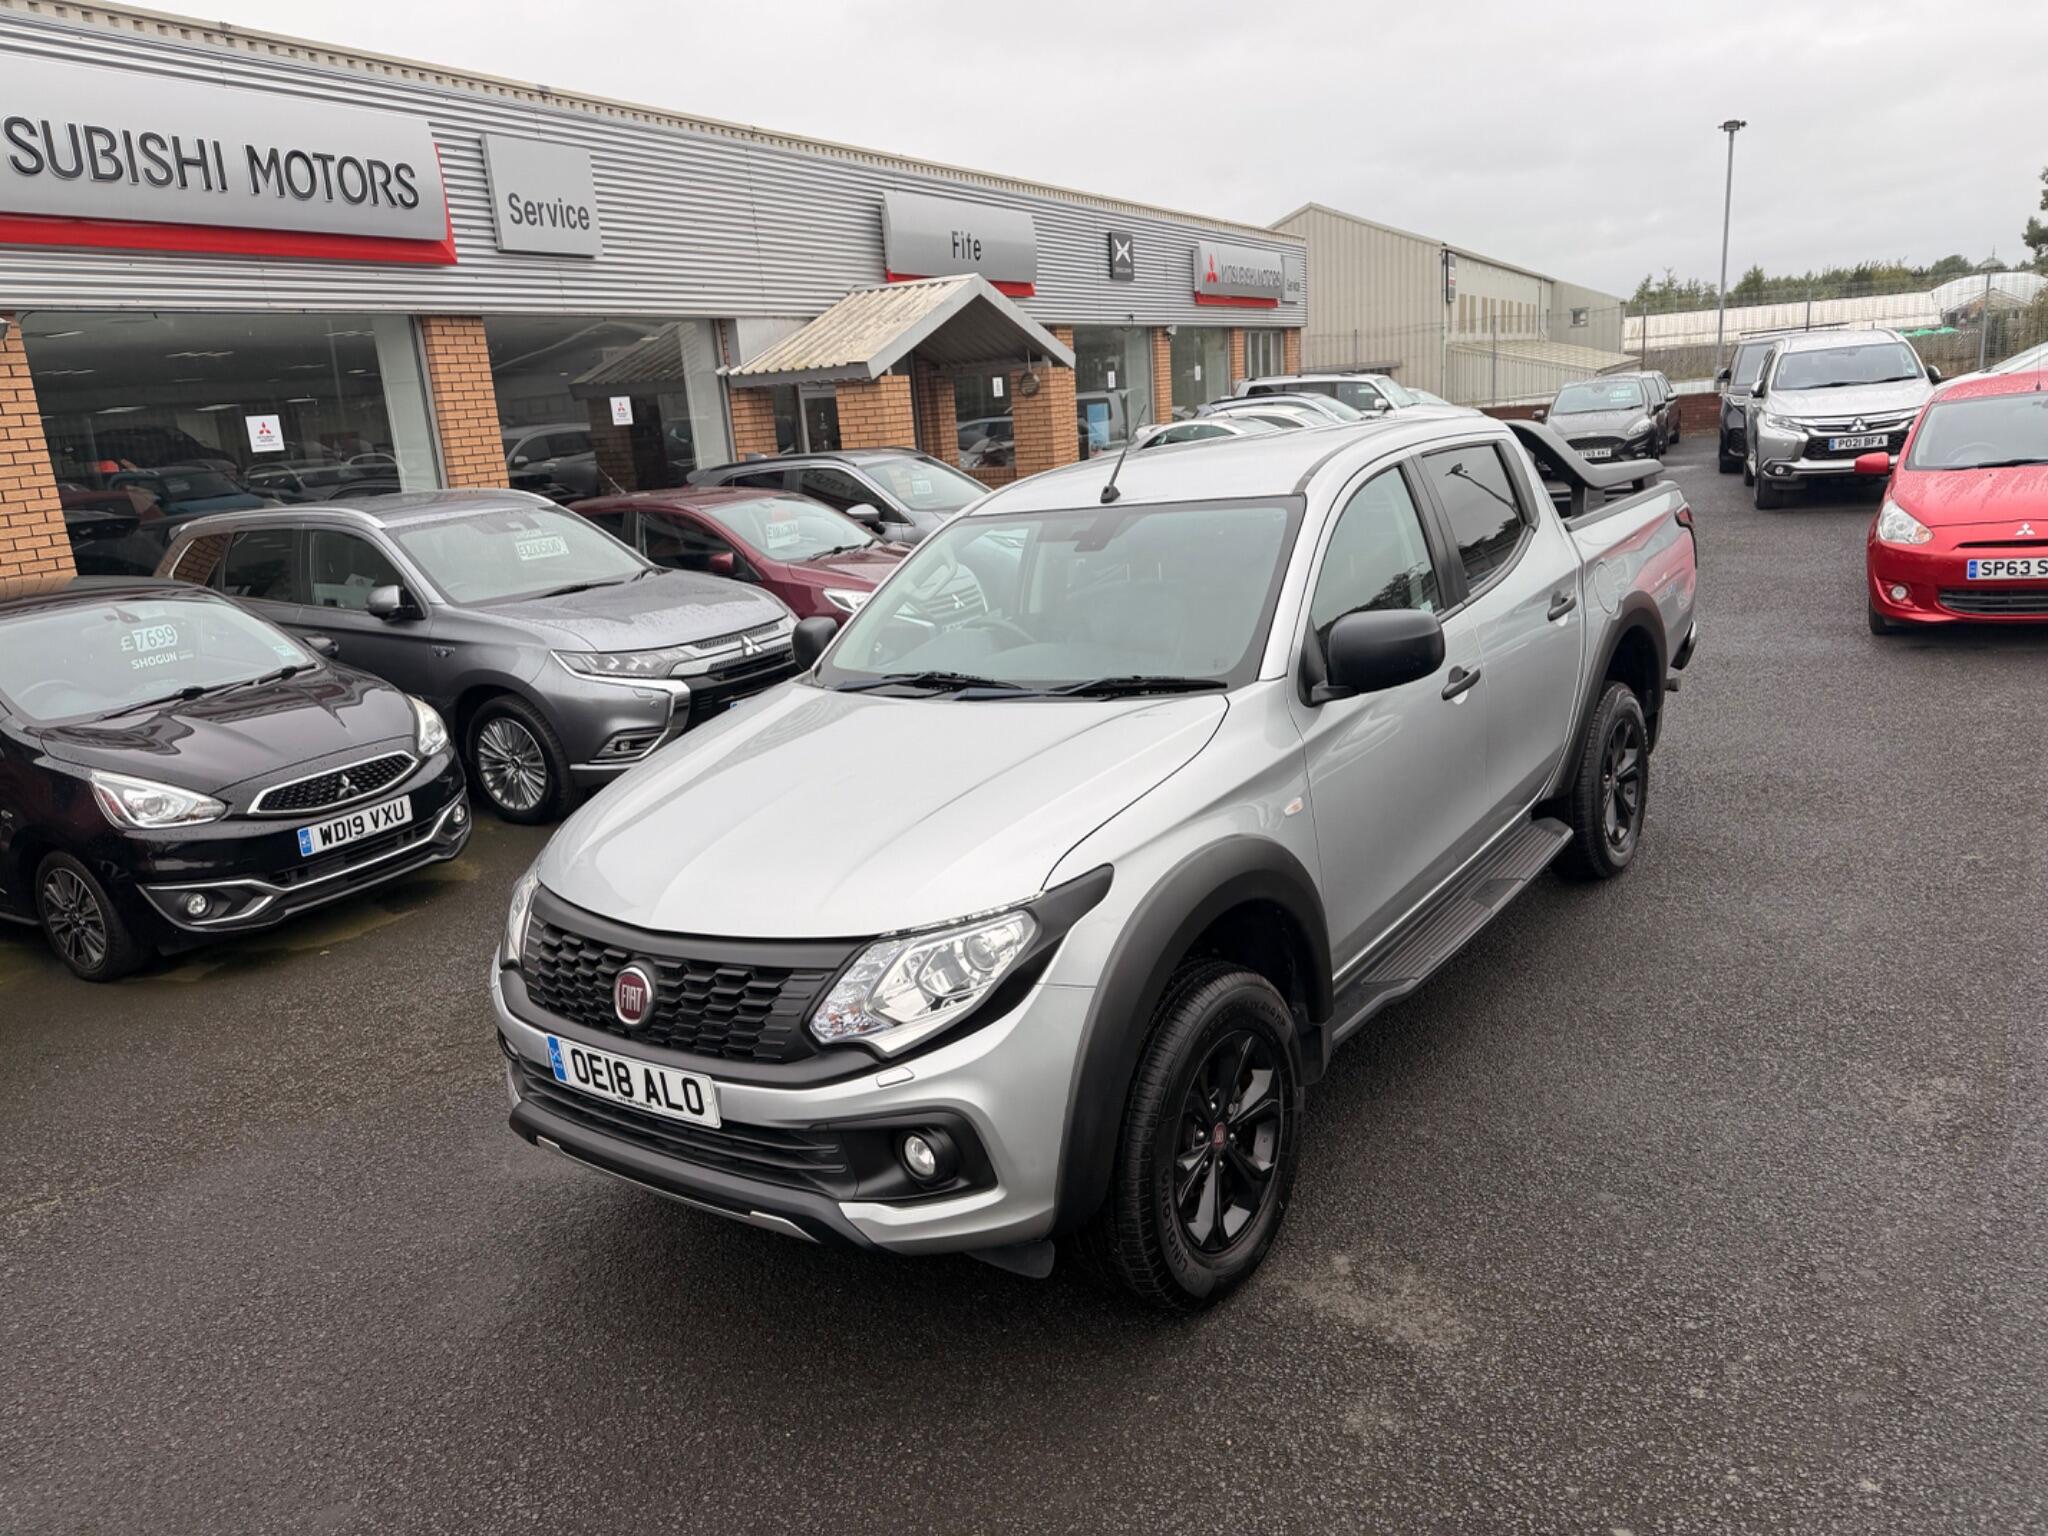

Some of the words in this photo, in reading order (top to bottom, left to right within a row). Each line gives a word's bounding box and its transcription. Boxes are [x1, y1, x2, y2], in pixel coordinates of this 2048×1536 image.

[2, 115, 228, 192] SUBISHI
[244, 144, 420, 210] MOTORS
[508, 192, 590, 230] Service
[951, 230, 982, 261] Fife
[1981, 561, 2032, 576] SP63
[120, 625, 177, 652] £7699
[131, 652, 177, 669] SHOGUN
[320, 815, 365, 846] WD19
[369, 801, 405, 829] VXU
[621, 984, 644, 1012] FIAT
[571, 1048, 634, 1098] OE18
[644, 1068, 705, 1116] ALO
